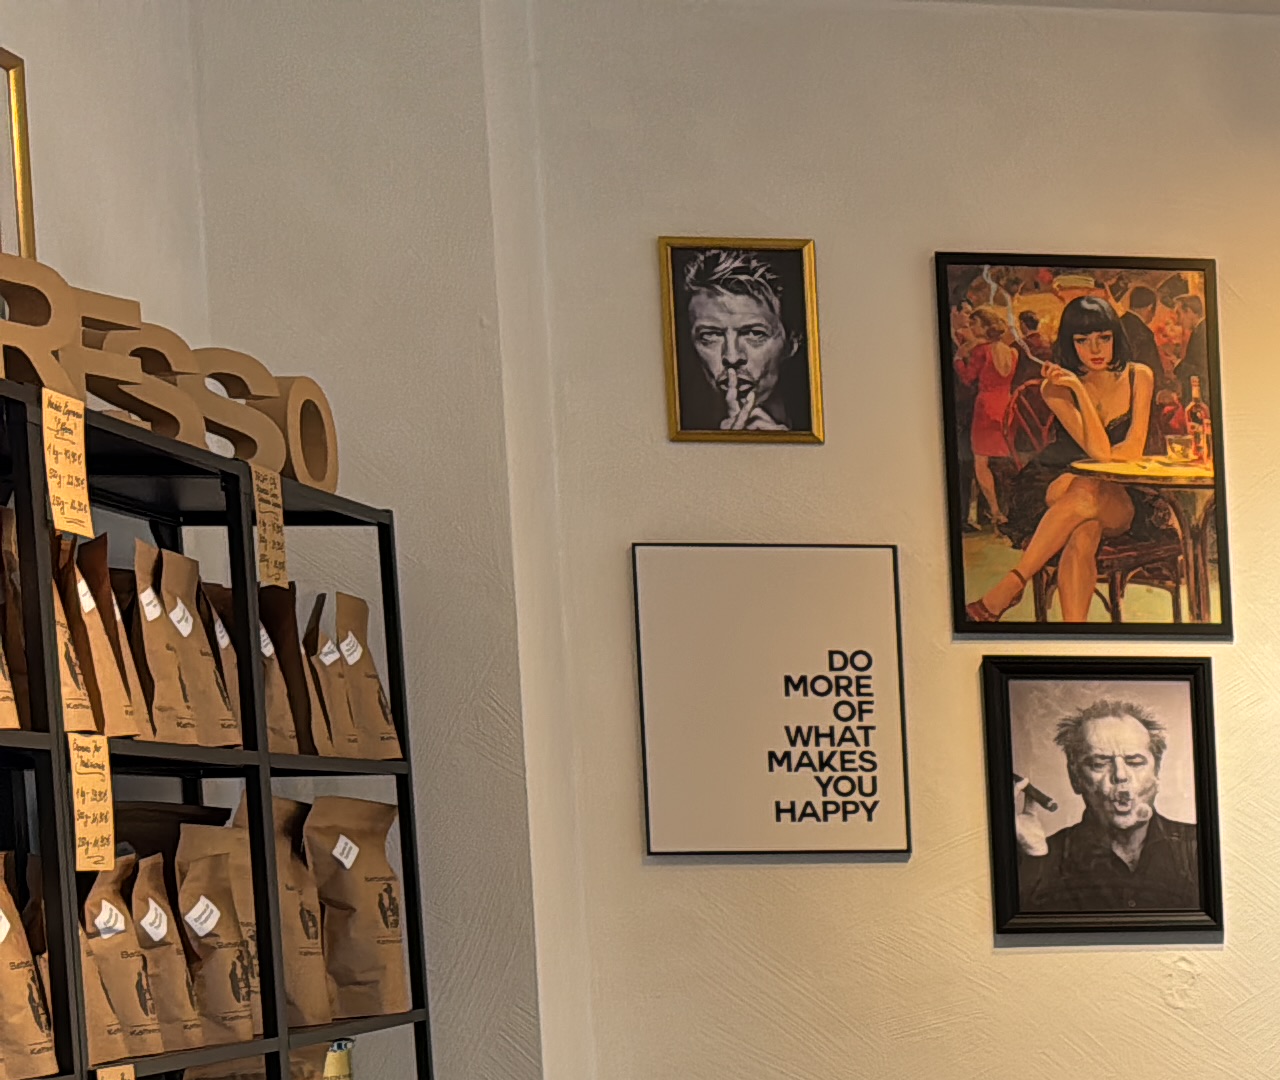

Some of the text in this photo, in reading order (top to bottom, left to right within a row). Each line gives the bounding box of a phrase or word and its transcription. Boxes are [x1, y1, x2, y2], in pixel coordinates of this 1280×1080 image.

[828, 649, 873, 672] DO
[784, 674, 875, 698] MORE
[833, 700, 875, 723] OF
[784, 725, 877, 748] WHAT
[767, 750, 879, 773] MAKES
[814, 775, 878, 798] YOU
[774, 800, 880, 823] HAPPY
